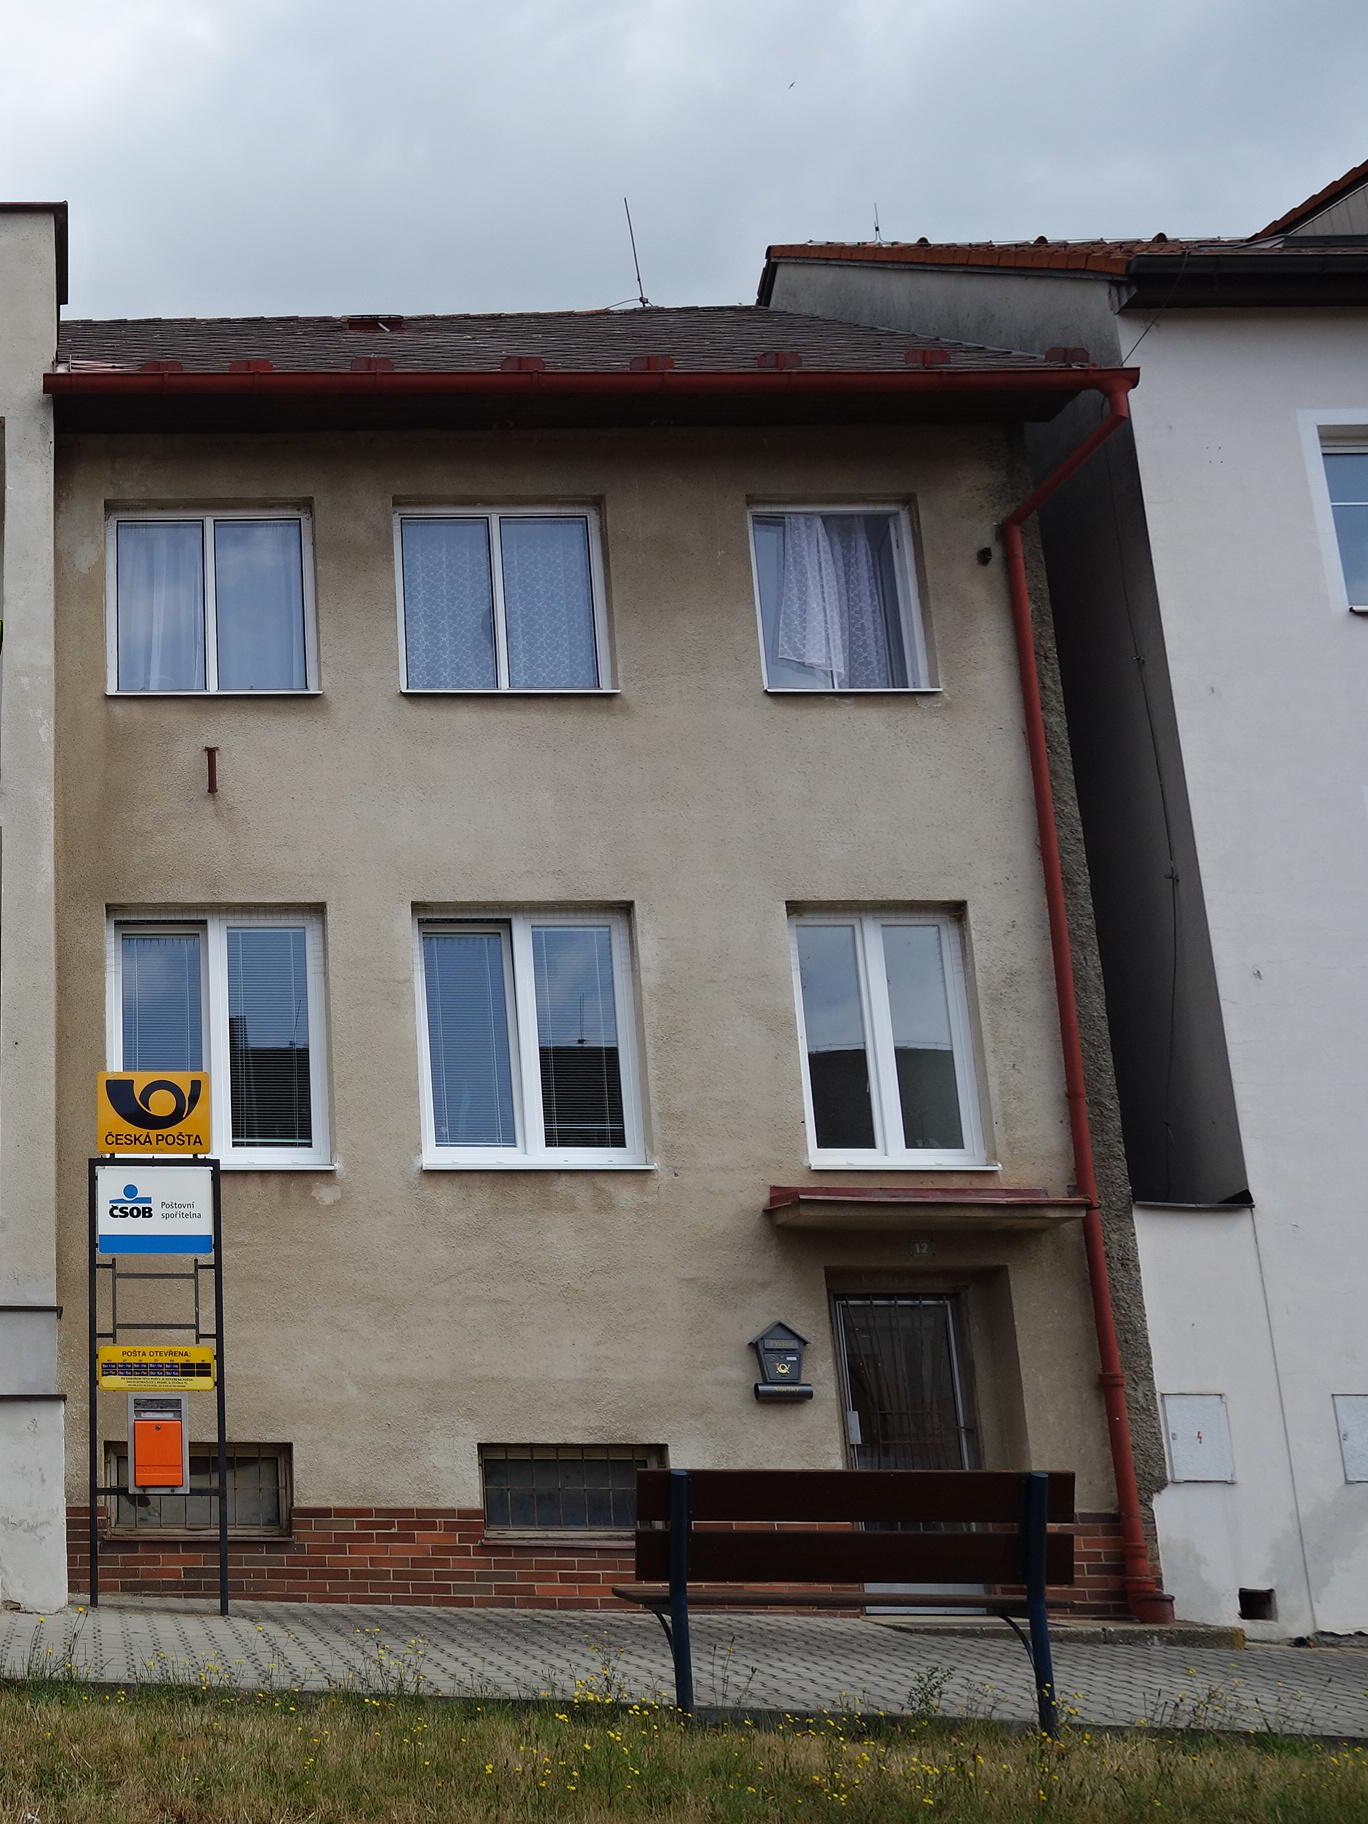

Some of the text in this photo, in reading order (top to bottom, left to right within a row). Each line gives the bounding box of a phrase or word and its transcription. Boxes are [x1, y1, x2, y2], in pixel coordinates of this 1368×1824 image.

[105, 1131, 203, 1146] ČESKÁ POŠTA
[160, 1201, 195, 1210] Poštovní
[109, 1204, 153, 1219] ČSOB
[160, 1210, 202, 1220] spořitelna
[915, 1242, 929, 1254] 12
[121, 1350, 192, 1358] POŠTA OTEVŘENA:
